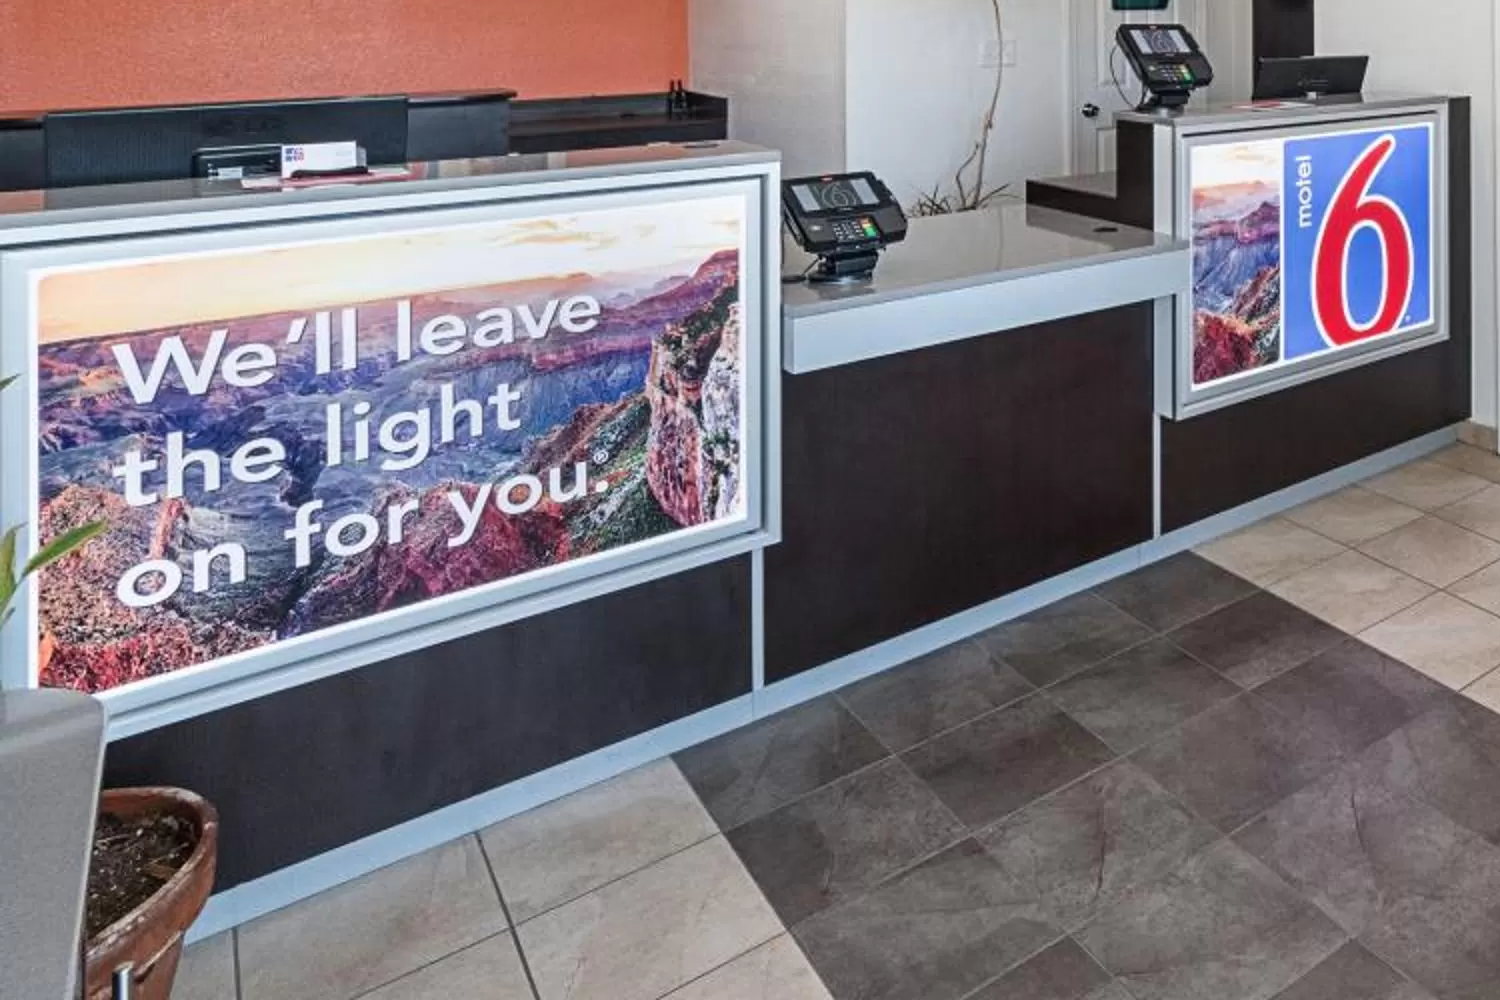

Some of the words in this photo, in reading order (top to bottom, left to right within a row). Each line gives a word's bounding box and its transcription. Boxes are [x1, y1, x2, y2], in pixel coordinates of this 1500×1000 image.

[1296, 155, 1312, 229] motel
[1311, 134, 1414, 349] 6
[112, 307, 358, 405] We’ll
[398, 293, 602, 363] leave
[113, 430, 286, 506] the
[326, 382, 523, 471] light
[115, 540, 247, 605] on
[285, 499, 423, 567] for
